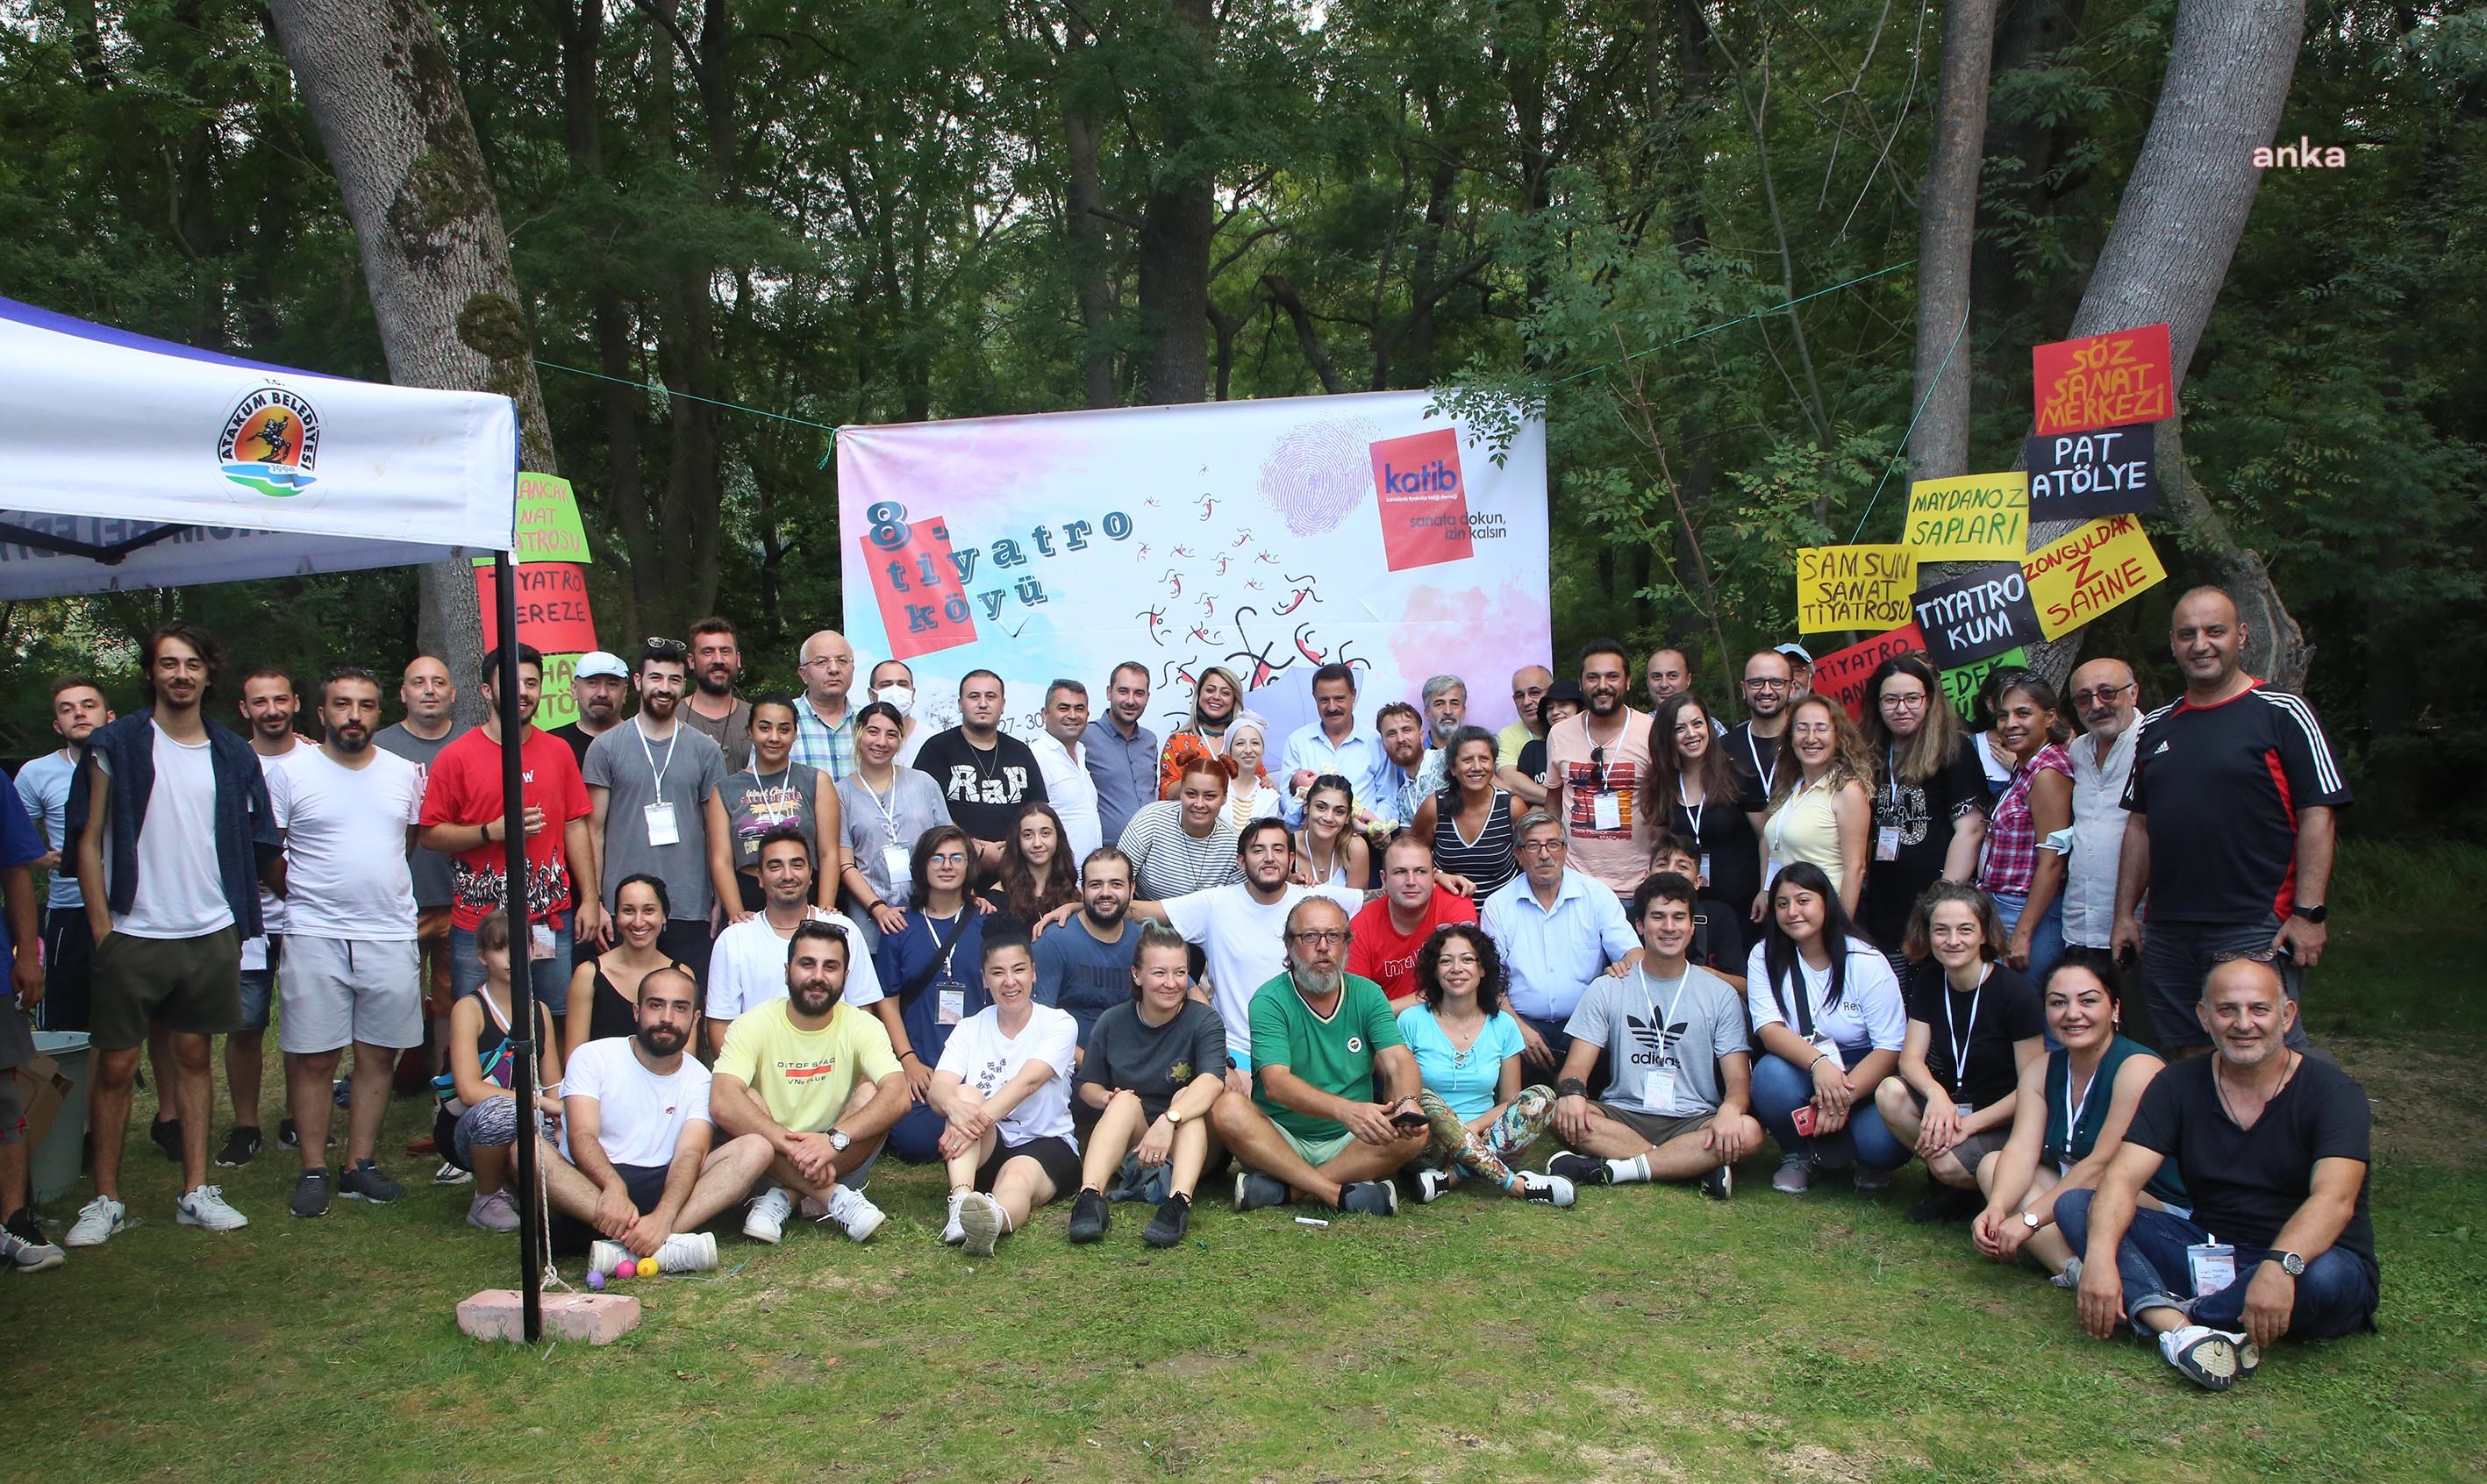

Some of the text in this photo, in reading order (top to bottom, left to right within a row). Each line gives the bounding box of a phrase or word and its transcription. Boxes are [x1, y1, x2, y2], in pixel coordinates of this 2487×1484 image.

[2065, 338, 2137, 375] SÖZ
[2046, 363, 2155, 407] SANAT
[2039, 382, 2165, 432] MERKEZİ
[221, 394, 268, 460] ATAKUM
[2055, 432, 2124, 466] PAT
[1385, 460, 1457, 494] katib
[2032, 461, 2148, 499] ATÖLYE
[519, 507, 556, 525] NAT
[1912, 488, 2029, 513] MAYDANOZ
[1410, 511, 1506, 528] sanata dokun,
[1445, 526, 1507, 541] izin kalsın
[1912, 512, 2019, 546] SAPLARI
[515, 529, 580, 553] ATROSU
[886, 511, 1133, 593] tiyatro
[2022, 514, 2135, 582] ZONGULDAK
[1803, 551, 1911, 581] SAMSUN
[2066, 555, 2105, 589] Z
[904, 575, 1048, 633] köyü
[1816, 580, 1898, 603] SANAT
[1916, 573, 2025, 630] TİYATRO
[2047, 558, 2148, 626] SAHNE
[517, 602, 587, 624] EREZE
[1803, 600, 1912, 625] TİYATROSU
[1947, 610, 2014, 651] KUM
[1815, 639, 1909, 681] TİYATRO
